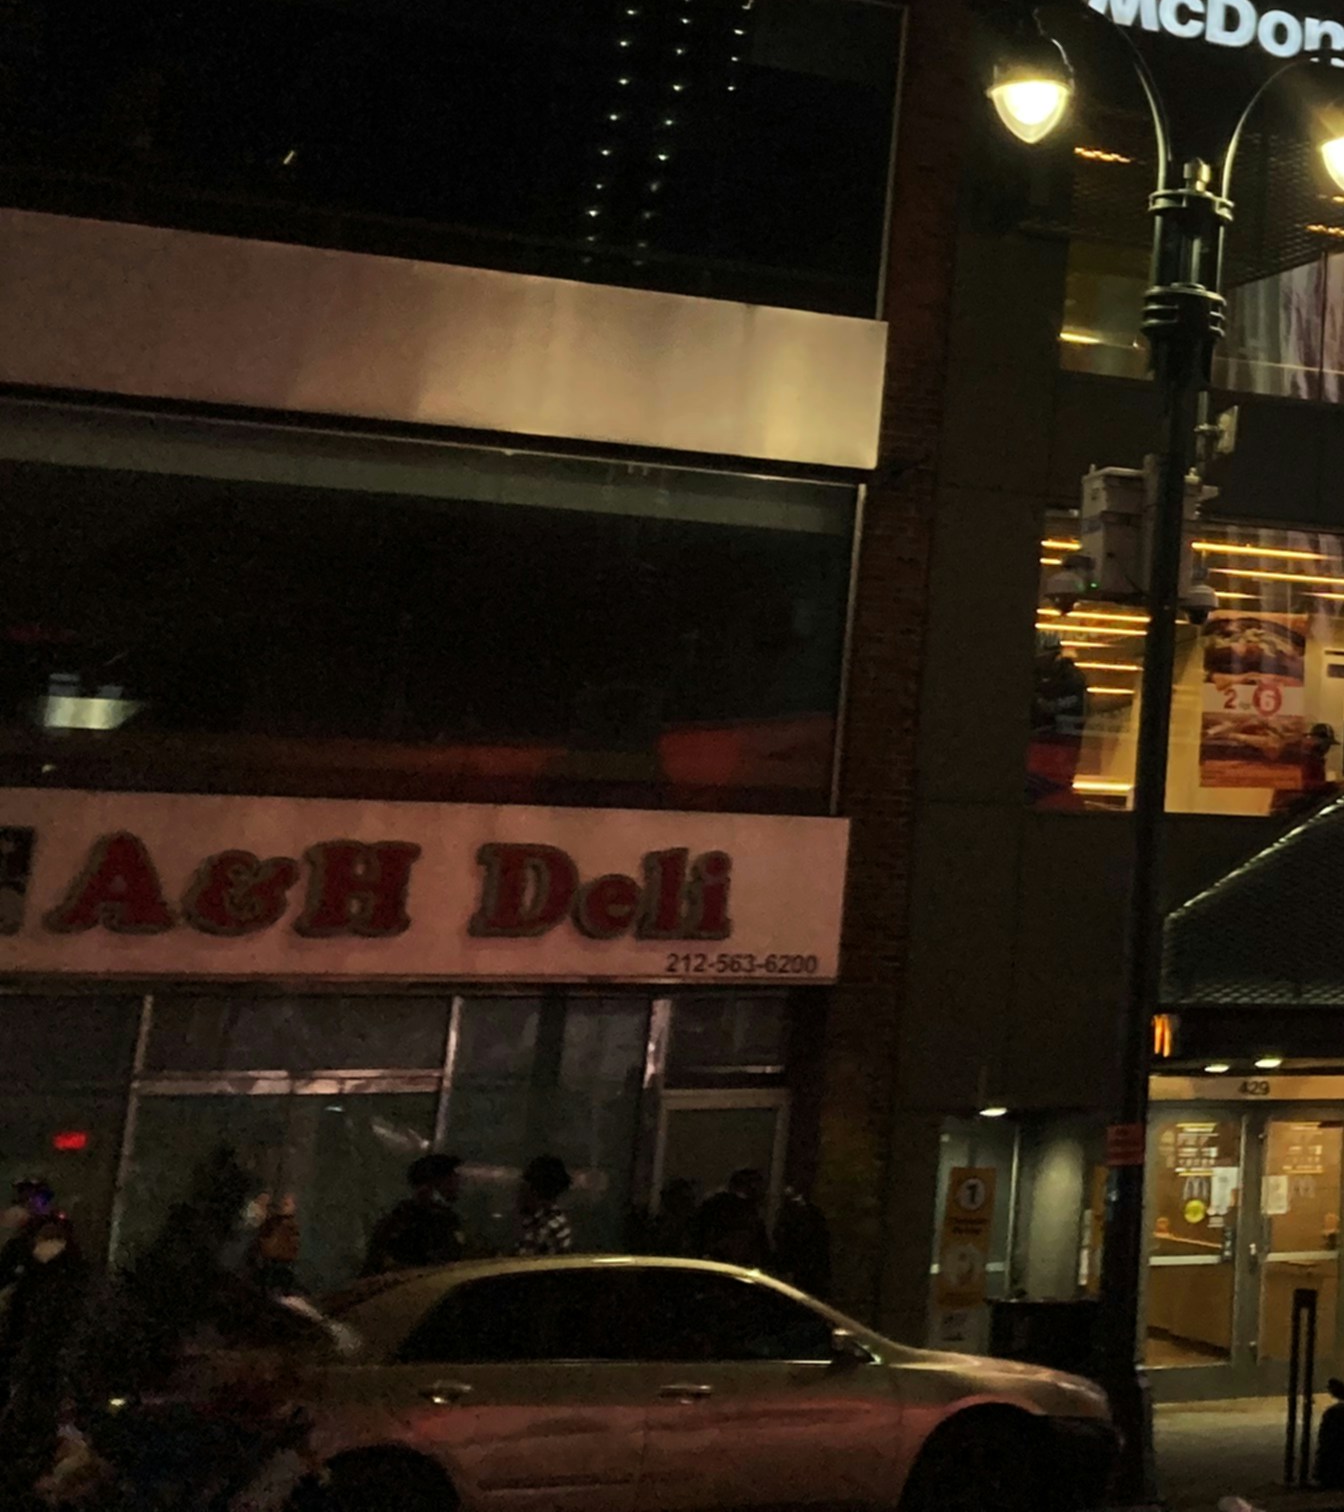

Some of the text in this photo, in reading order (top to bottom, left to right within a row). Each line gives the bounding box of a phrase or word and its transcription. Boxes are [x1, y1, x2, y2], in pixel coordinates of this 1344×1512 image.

[1224, 688, 1238, 709] 2
[470, 842, 733, 941] Deli
[664, 952, 818, 976] 212-563-6200
[1238, 1081, 1270, 1095] 429
